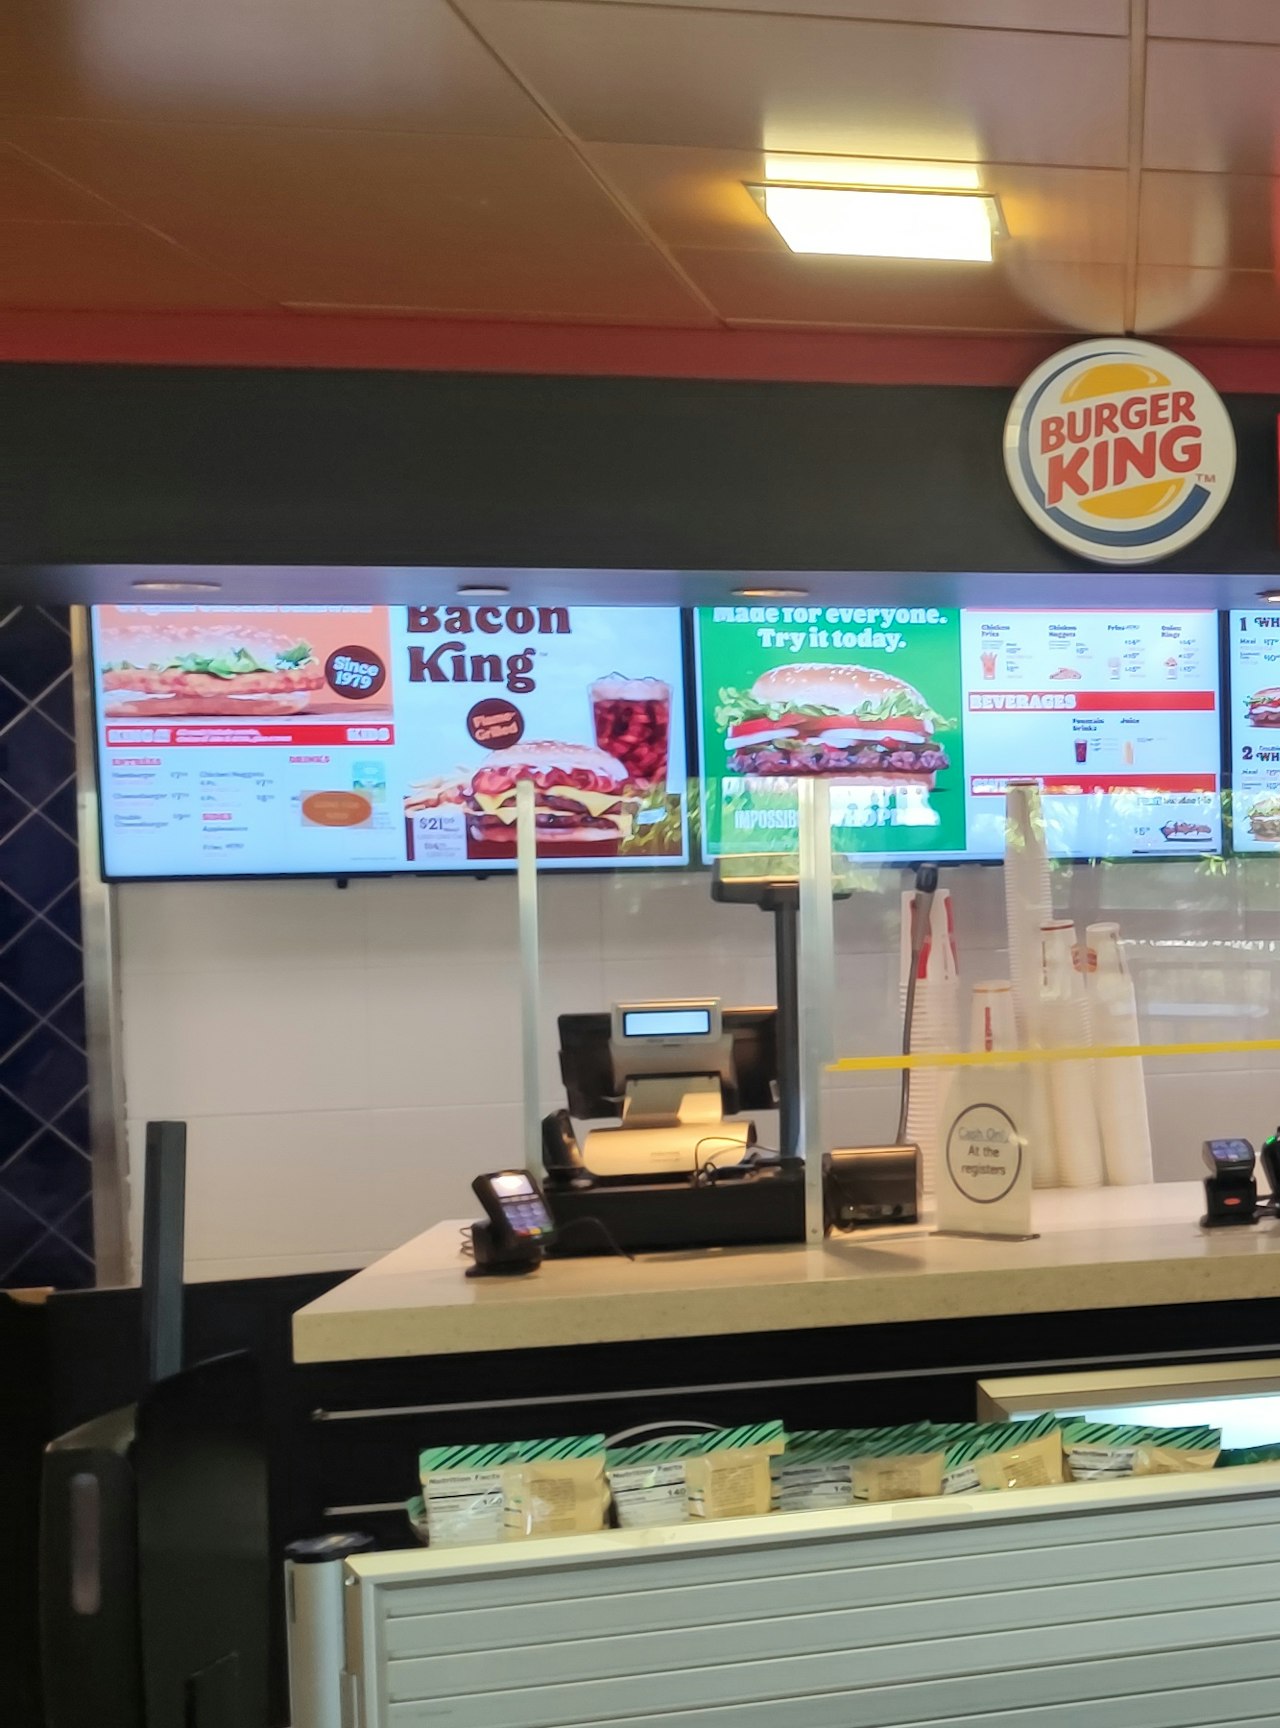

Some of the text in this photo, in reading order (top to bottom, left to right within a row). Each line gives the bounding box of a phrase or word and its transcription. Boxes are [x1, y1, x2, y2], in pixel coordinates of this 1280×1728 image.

[1040, 391, 1196, 455] BURGER
[1047, 425, 1203, 507] KING
[407, 606, 573, 634] Bacon
[825, 606, 949, 628] everyone.
[1239, 616, 1248, 632] 1
[757, 625, 907, 653] Try it today.
[331, 655, 380, 677] Since
[406, 640, 536, 694] King
[333, 670, 373, 690] 1979
[969, 693, 1077, 710] BEVERAGES
[1241, 745, 1254, 760] 2
[735, 809, 799, 829] IMPOSSIB
[967, 1144, 1000, 1158] At the
[960, 1163, 1007, 1178] registers
[428, 1475, 471, 1485] Nutrition
[612, 1468, 653, 1479] Nutrition
